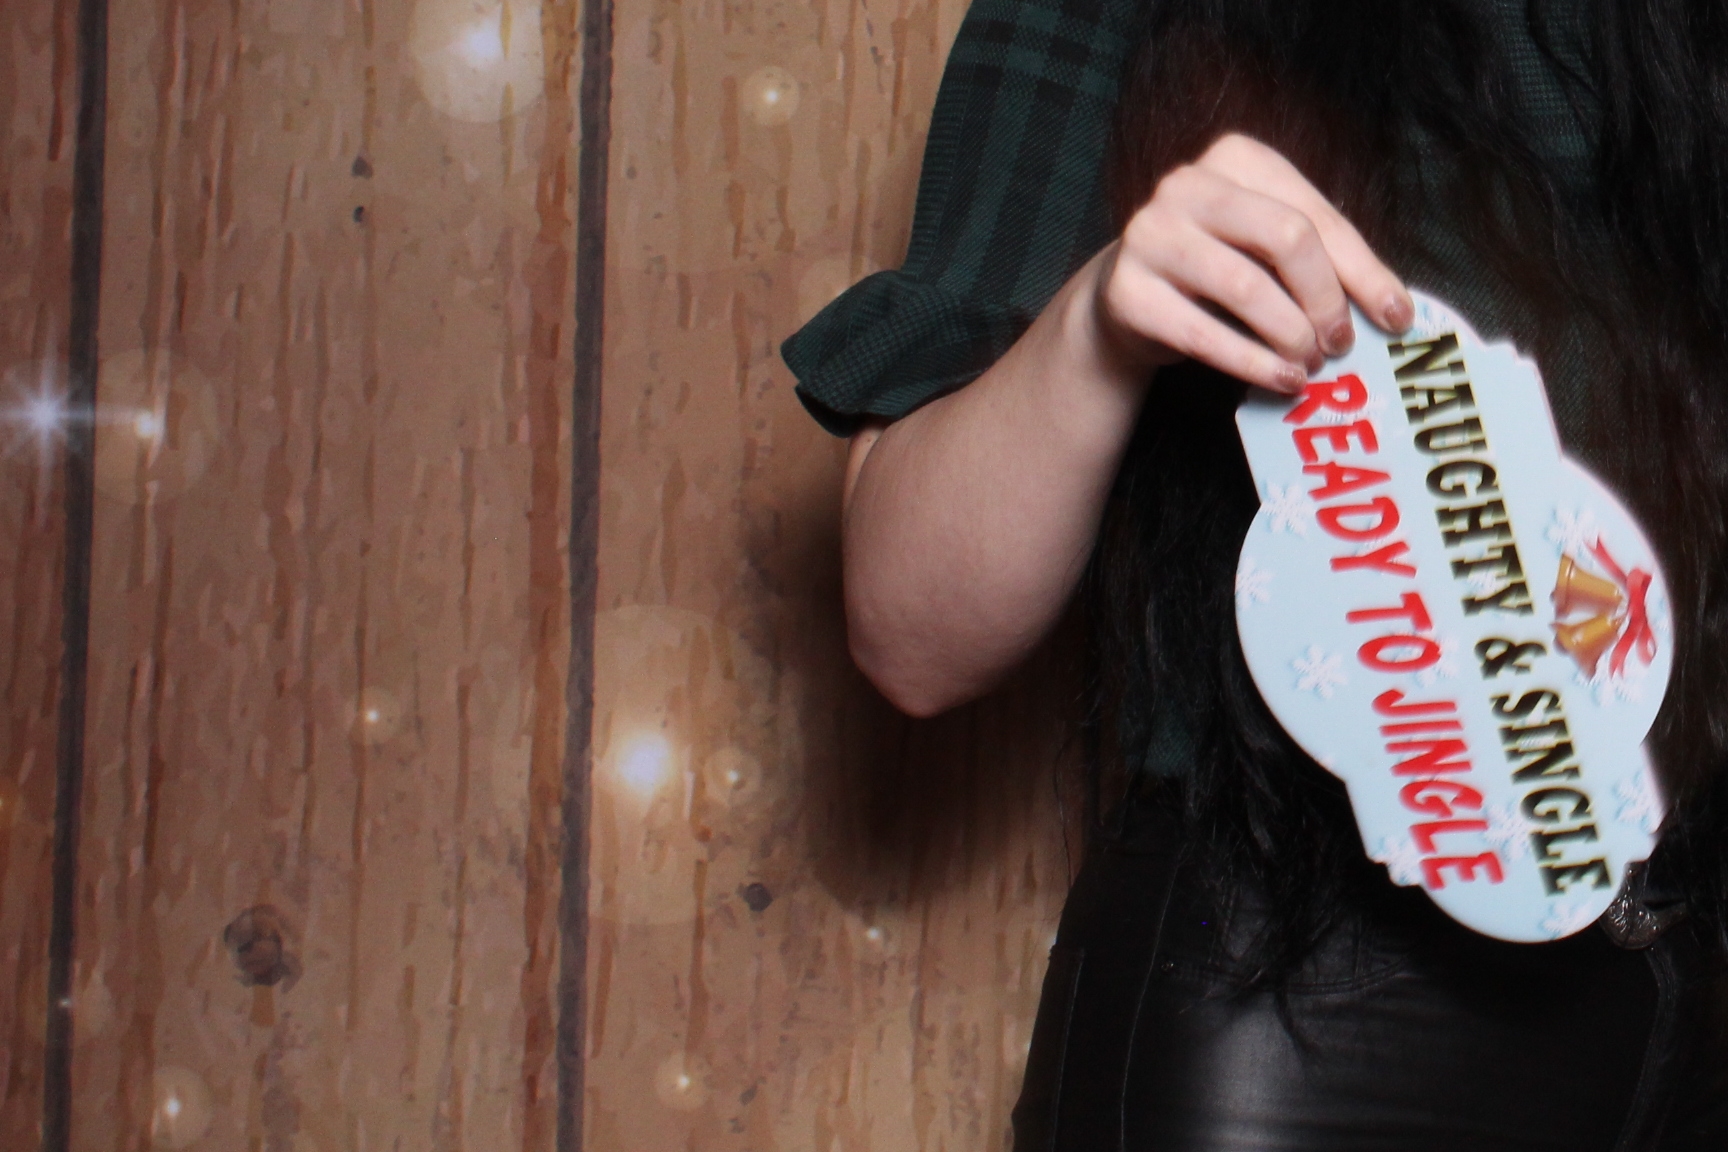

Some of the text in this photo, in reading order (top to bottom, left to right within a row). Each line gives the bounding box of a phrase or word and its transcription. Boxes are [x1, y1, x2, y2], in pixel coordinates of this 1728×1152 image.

[1282, 371, 1504, 892] READY TO JINGLE
[1387, 332, 1612, 897] NAUGHTY & SINGLE
